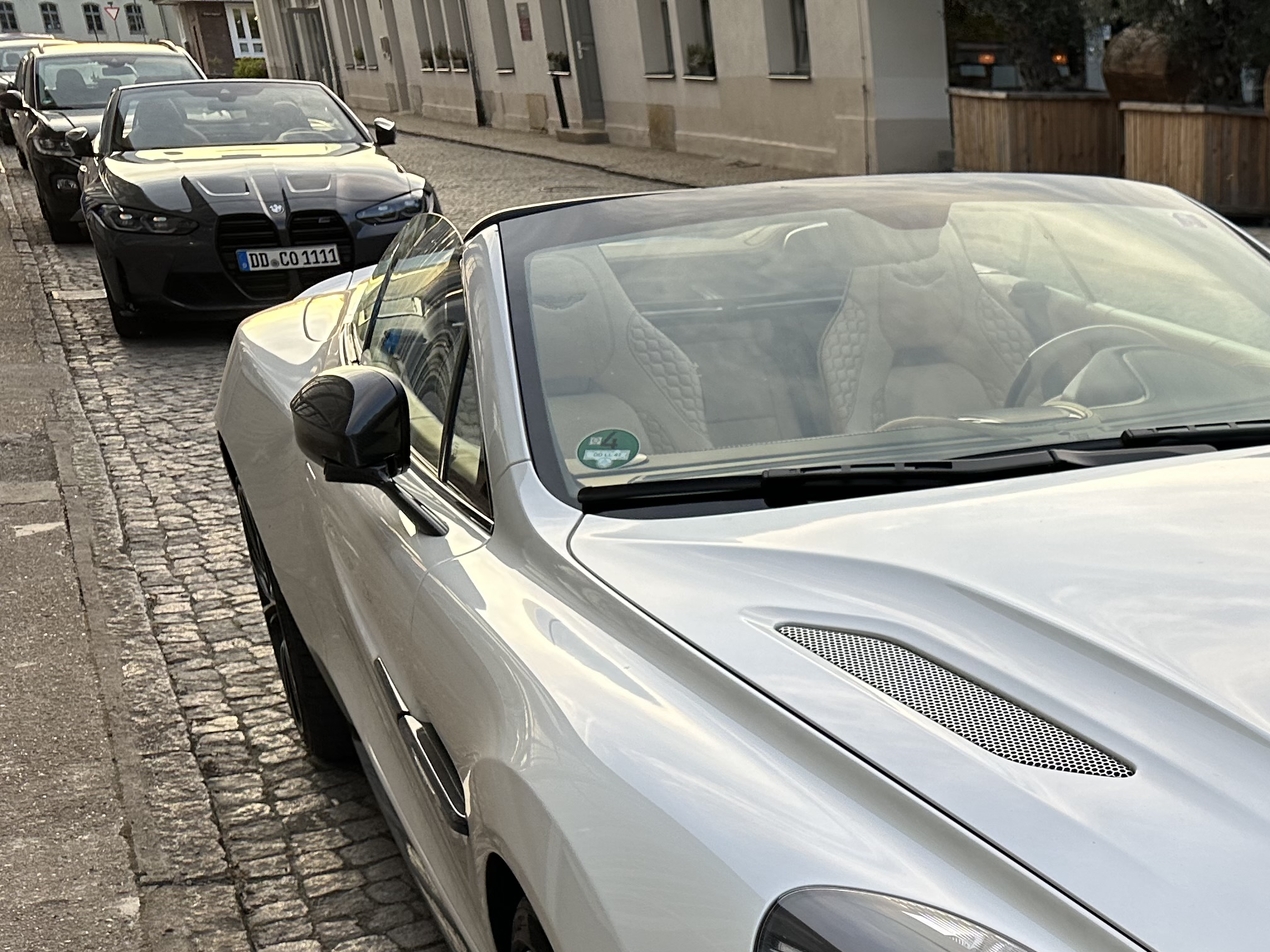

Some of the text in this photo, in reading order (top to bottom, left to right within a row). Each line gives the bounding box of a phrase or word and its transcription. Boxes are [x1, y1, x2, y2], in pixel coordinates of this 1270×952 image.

[248, 252, 270, 268] DD
[279, 251, 299, 267] CO
[301, 248, 338, 266] 1111
[601, 431, 618, 450] 4
